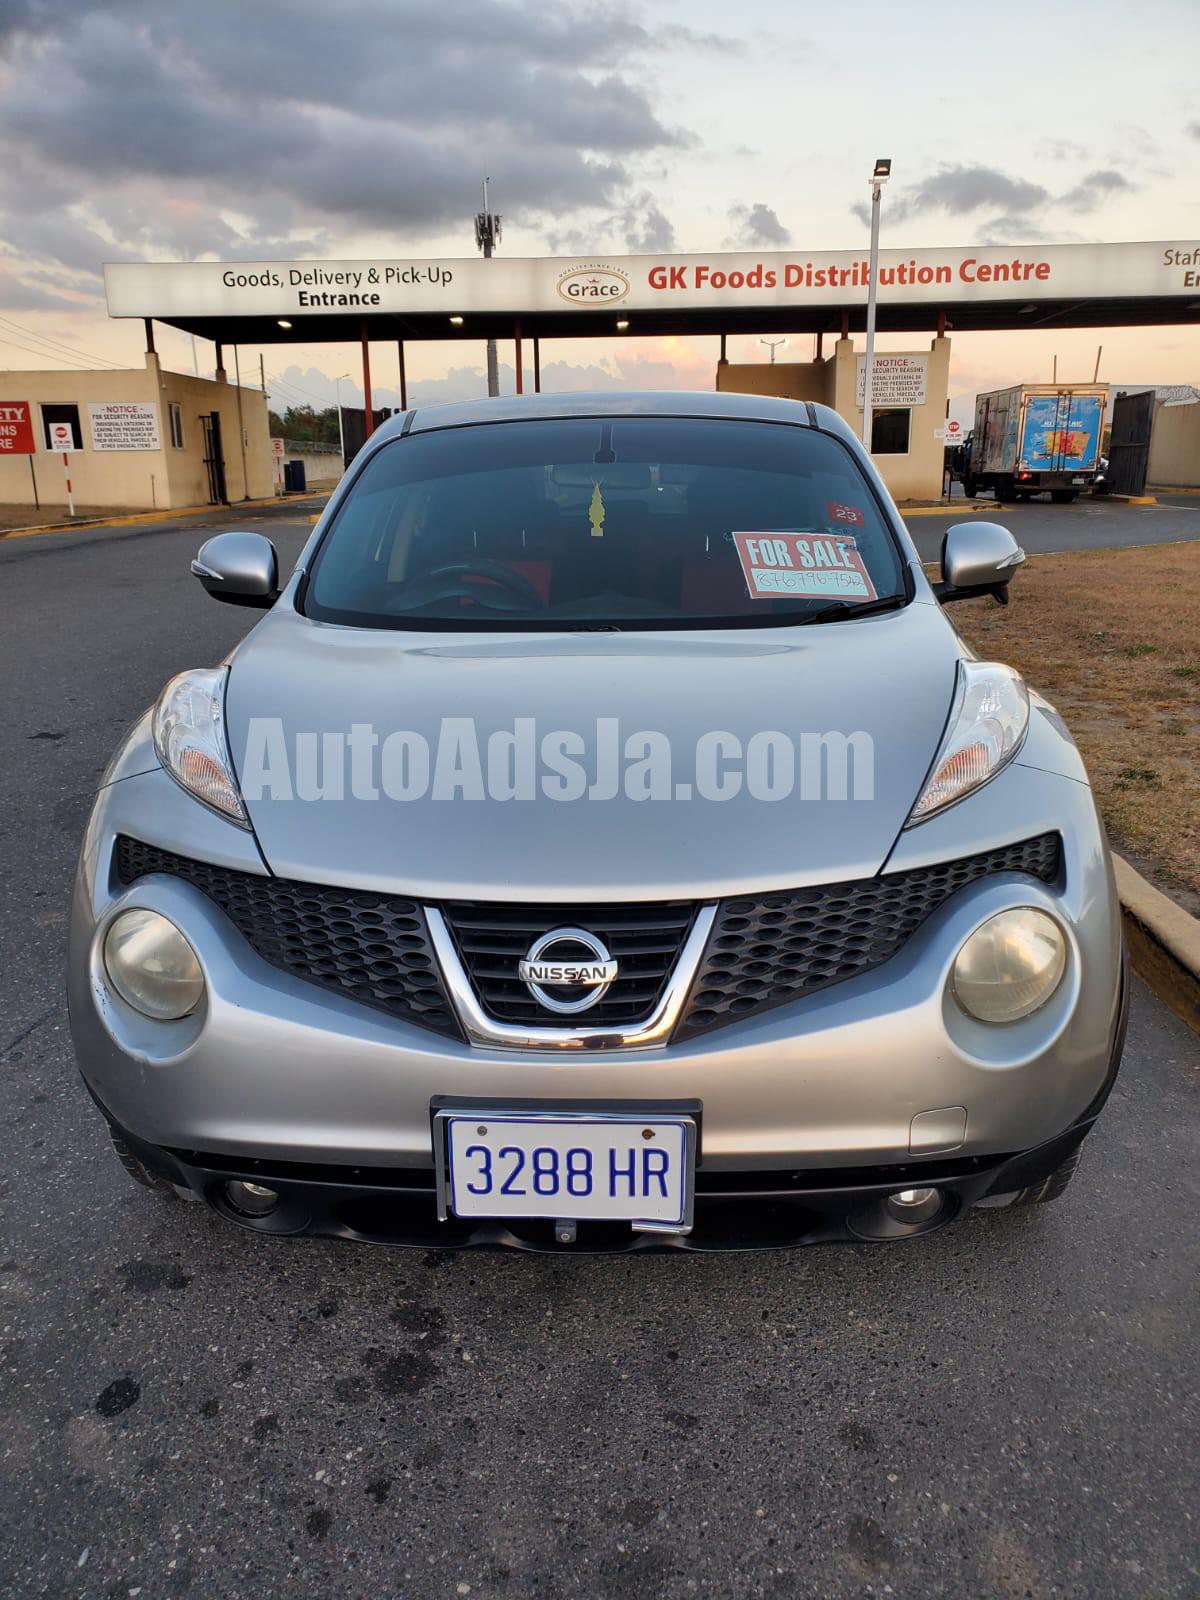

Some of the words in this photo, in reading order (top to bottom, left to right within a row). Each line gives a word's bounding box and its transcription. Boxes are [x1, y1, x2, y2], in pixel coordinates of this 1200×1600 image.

[1163, 248, 1200, 265] Staf
[222, 270, 284, 288] Goods,
[289, 268, 362, 288] Delivery
[367, 268, 380, 283] &
[385, 266, 453, 287] Pick-Up
[648, 266, 687, 289] GK
[695, 263, 777, 288] Foods
[785, 260, 952, 287] Distribution
[959, 259, 1050, 282] Centre
[567, 283, 620, 296] Grace
[298, 291, 381, 306] Entrance
[876, 359, 909, 367] NOTICE
[106, 405, 138, 413] NOTICE
[0, 425, 17, 436] NS
[836, 508, 858, 521] 23
[745, 538, 794, 567] FOR
[795, 540, 857, 568] SALE
[528, 966, 607, 980] NISSAN
[465, 1145, 593, 1197] 3288
[609, 1147, 670, 1198] HR
